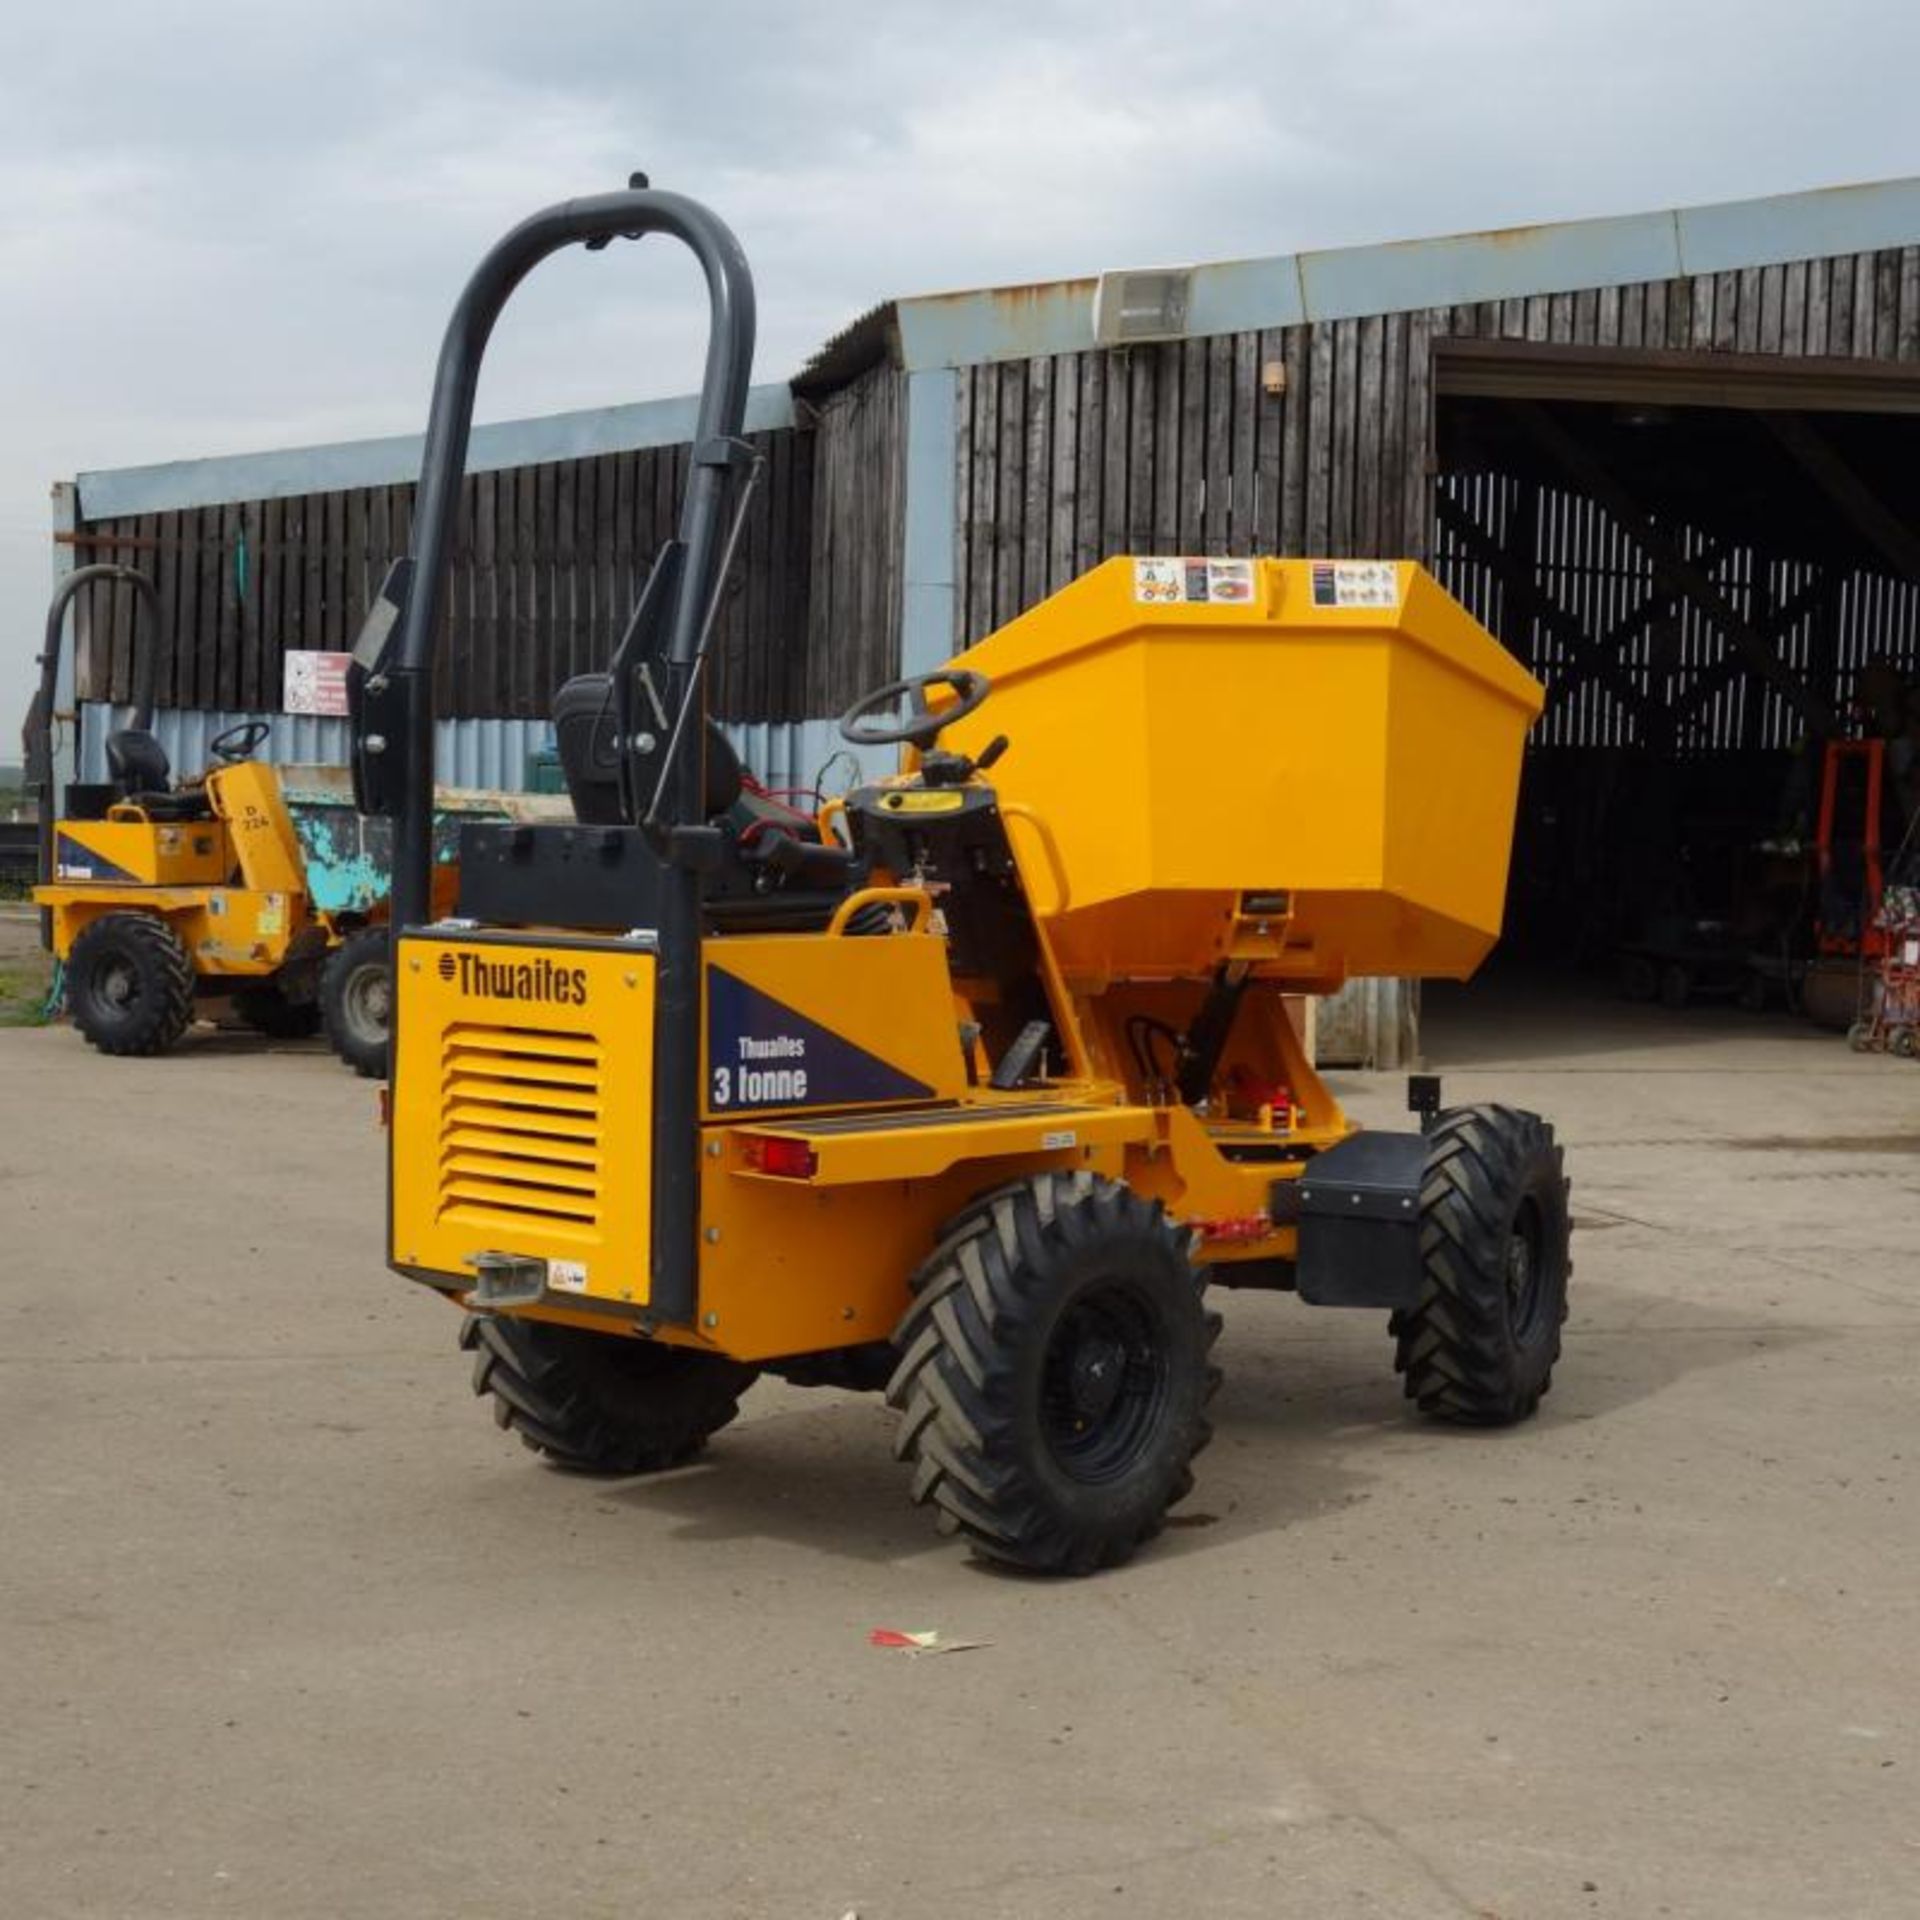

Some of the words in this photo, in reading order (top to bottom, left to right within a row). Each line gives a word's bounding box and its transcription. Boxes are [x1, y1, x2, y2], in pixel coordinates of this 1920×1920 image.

[245, 806, 257, 817] D
[457, 952, 586, 1006] Thwaites
[739, 1036, 805, 1059] Thwaites
[715, 1067, 730, 1104] 3
[739, 1066, 807, 1102] tonne
